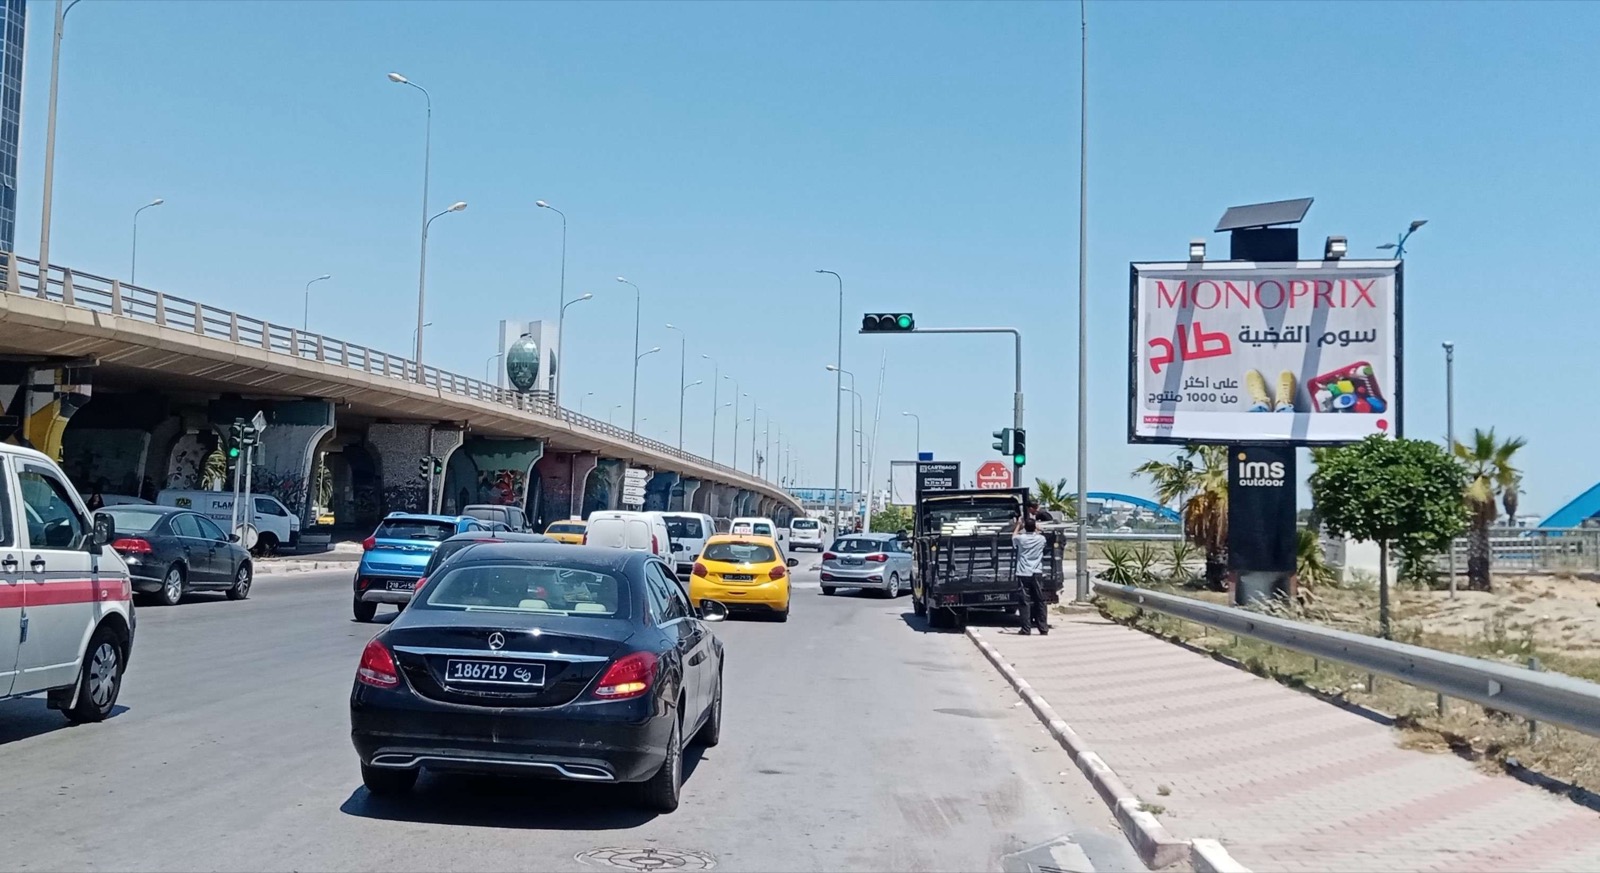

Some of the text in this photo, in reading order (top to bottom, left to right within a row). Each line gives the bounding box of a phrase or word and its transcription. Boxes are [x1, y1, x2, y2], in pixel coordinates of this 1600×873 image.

[1155, 279, 1377, 310] MONOPRIX
[1238, 325, 1377, 348] سوم القضية
[1148, 321, 1232, 375] طاح
[1183, 376, 1239, 390] على أكثر
[1148, 391, 1238, 404] من 1000 منتوج
[1238, 452, 1285, 478] ims
[981, 481, 1007, 489] STOP
[1239, 478, 1285, 487] outdoor
[454, 663, 508, 679] 186719
